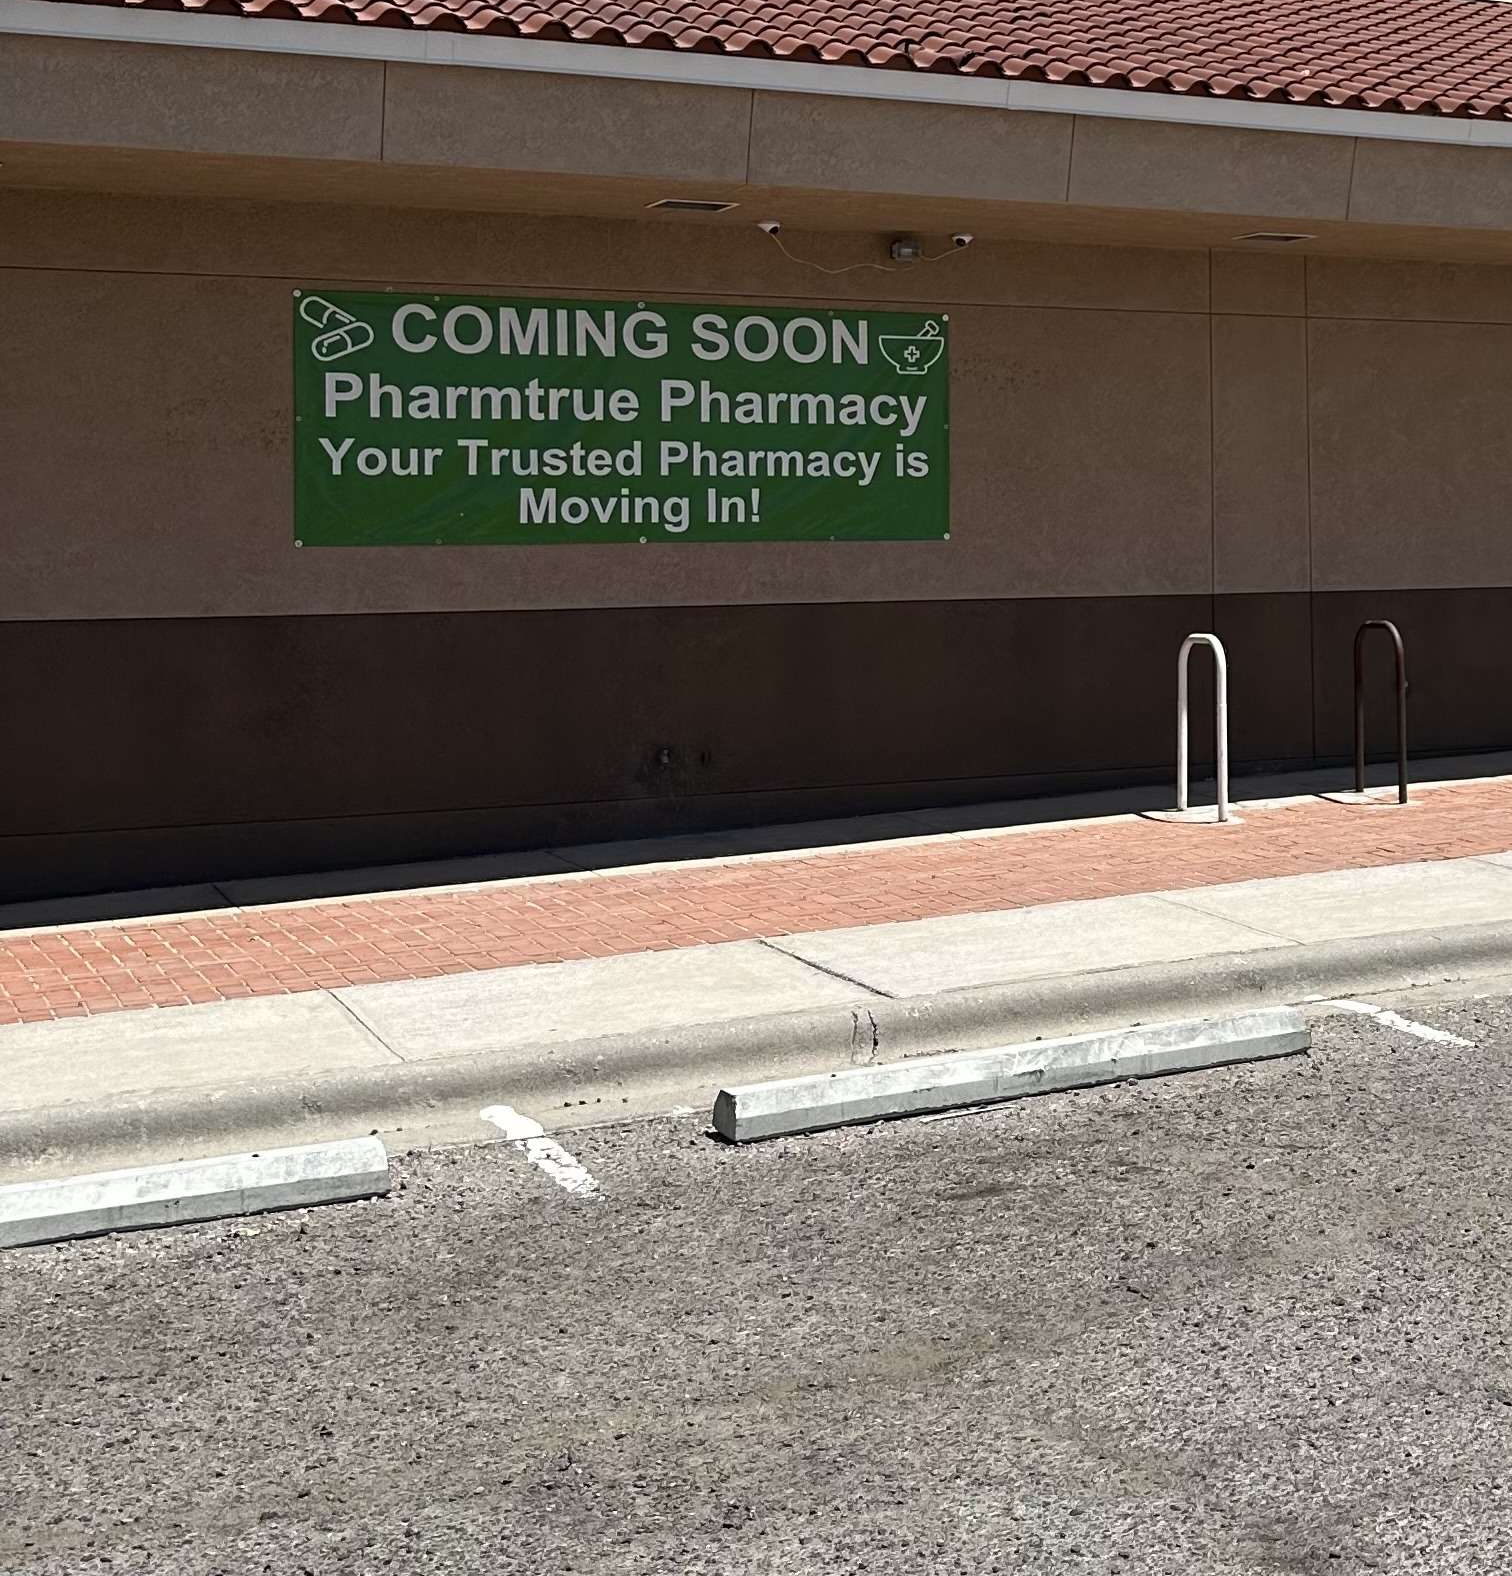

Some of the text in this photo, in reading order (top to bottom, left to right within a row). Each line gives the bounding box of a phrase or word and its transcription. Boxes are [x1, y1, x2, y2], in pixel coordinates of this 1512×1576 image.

[391, 303, 868, 365] COMING SOON
[323, 371, 927, 437] Pharmtrue Pharmacy
[318, 437, 930, 487] Your Trusted Pharmacy is
[518, 486, 761, 533] Moving In!
